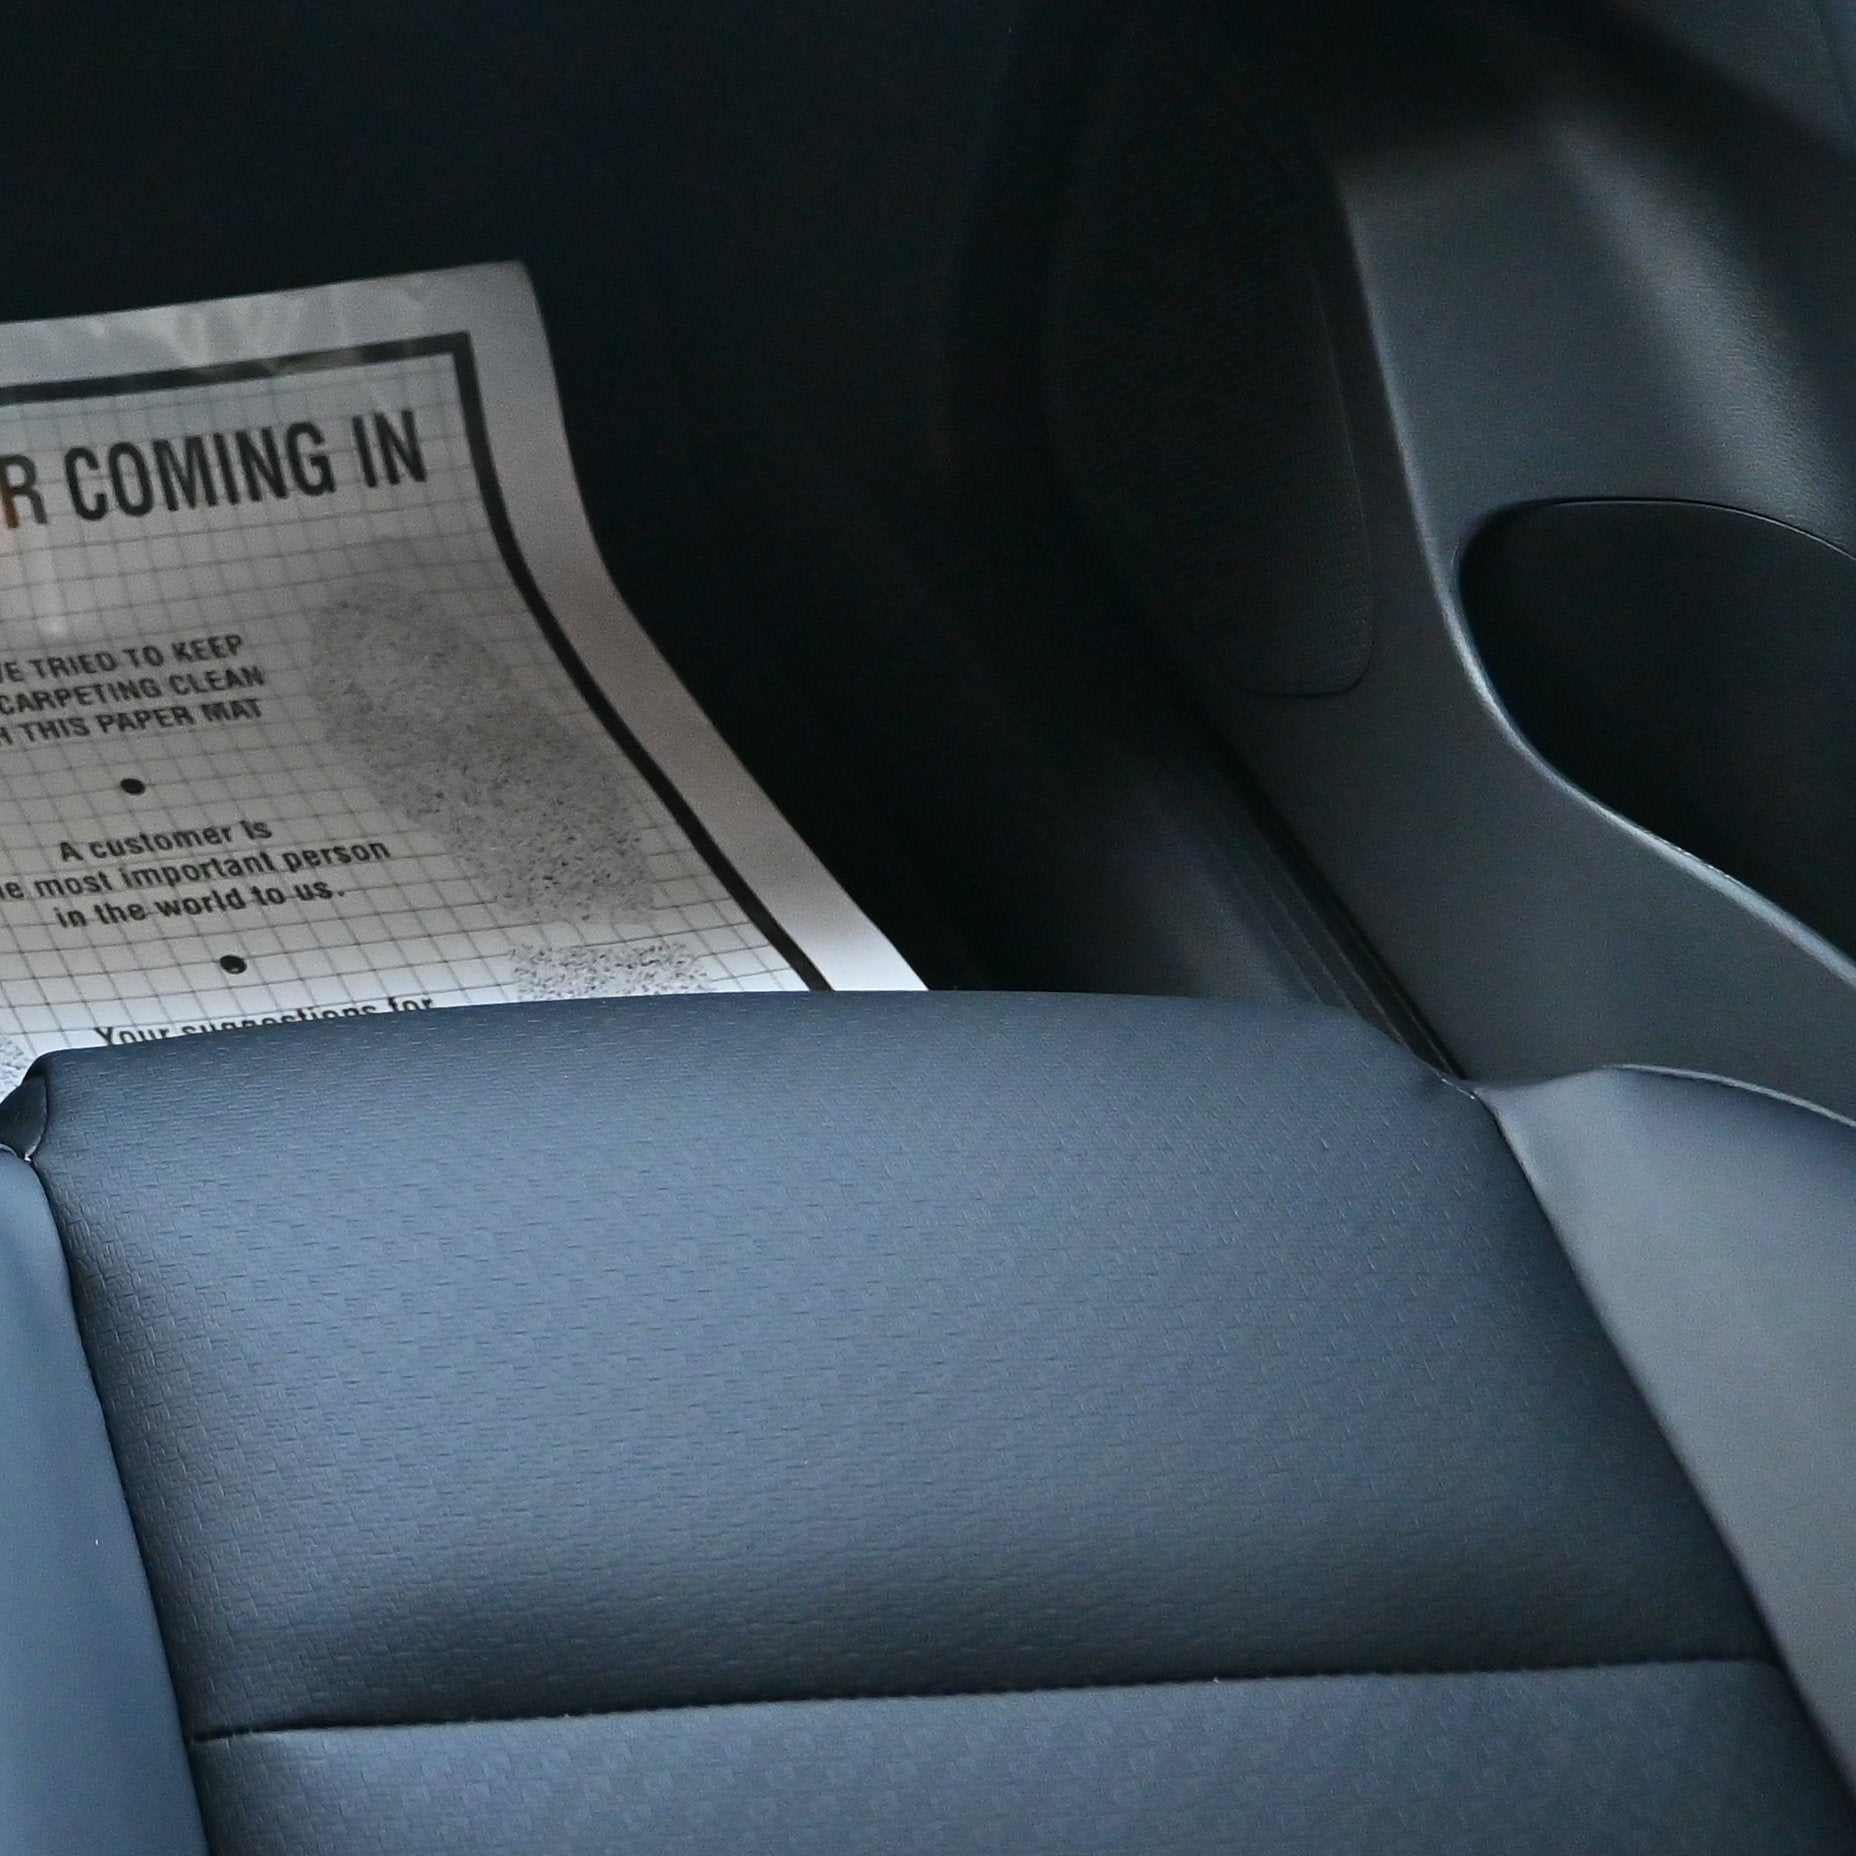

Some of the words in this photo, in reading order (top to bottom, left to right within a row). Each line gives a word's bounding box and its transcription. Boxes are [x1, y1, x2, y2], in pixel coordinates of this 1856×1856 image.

[64, 420, 337, 522] COMING
[352, 408, 427, 488] IN
[28, 651, 119, 681] TRIED
[123, 645, 165, 670] TO
[171, 634, 244, 662] KEEP
[168, 665, 266, 697] CLEAN
[21, 716, 92, 743] THIS
[95, 706, 195, 735] PAPER
[202, 698, 263, 723] MAT
[59, 841, 84, 863] A
[89, 824, 233, 861] customer
[241, 819, 274, 841] is
[33, 870, 113, 898] most
[121, 850, 278, 890] important
[286, 841, 391, 875] person
[55, 906, 88, 929] in
[94, 899, 147, 926] the
[155, 887, 248, 919] world
[253, 884, 286, 907] to
[293, 878, 345, 902] us.
